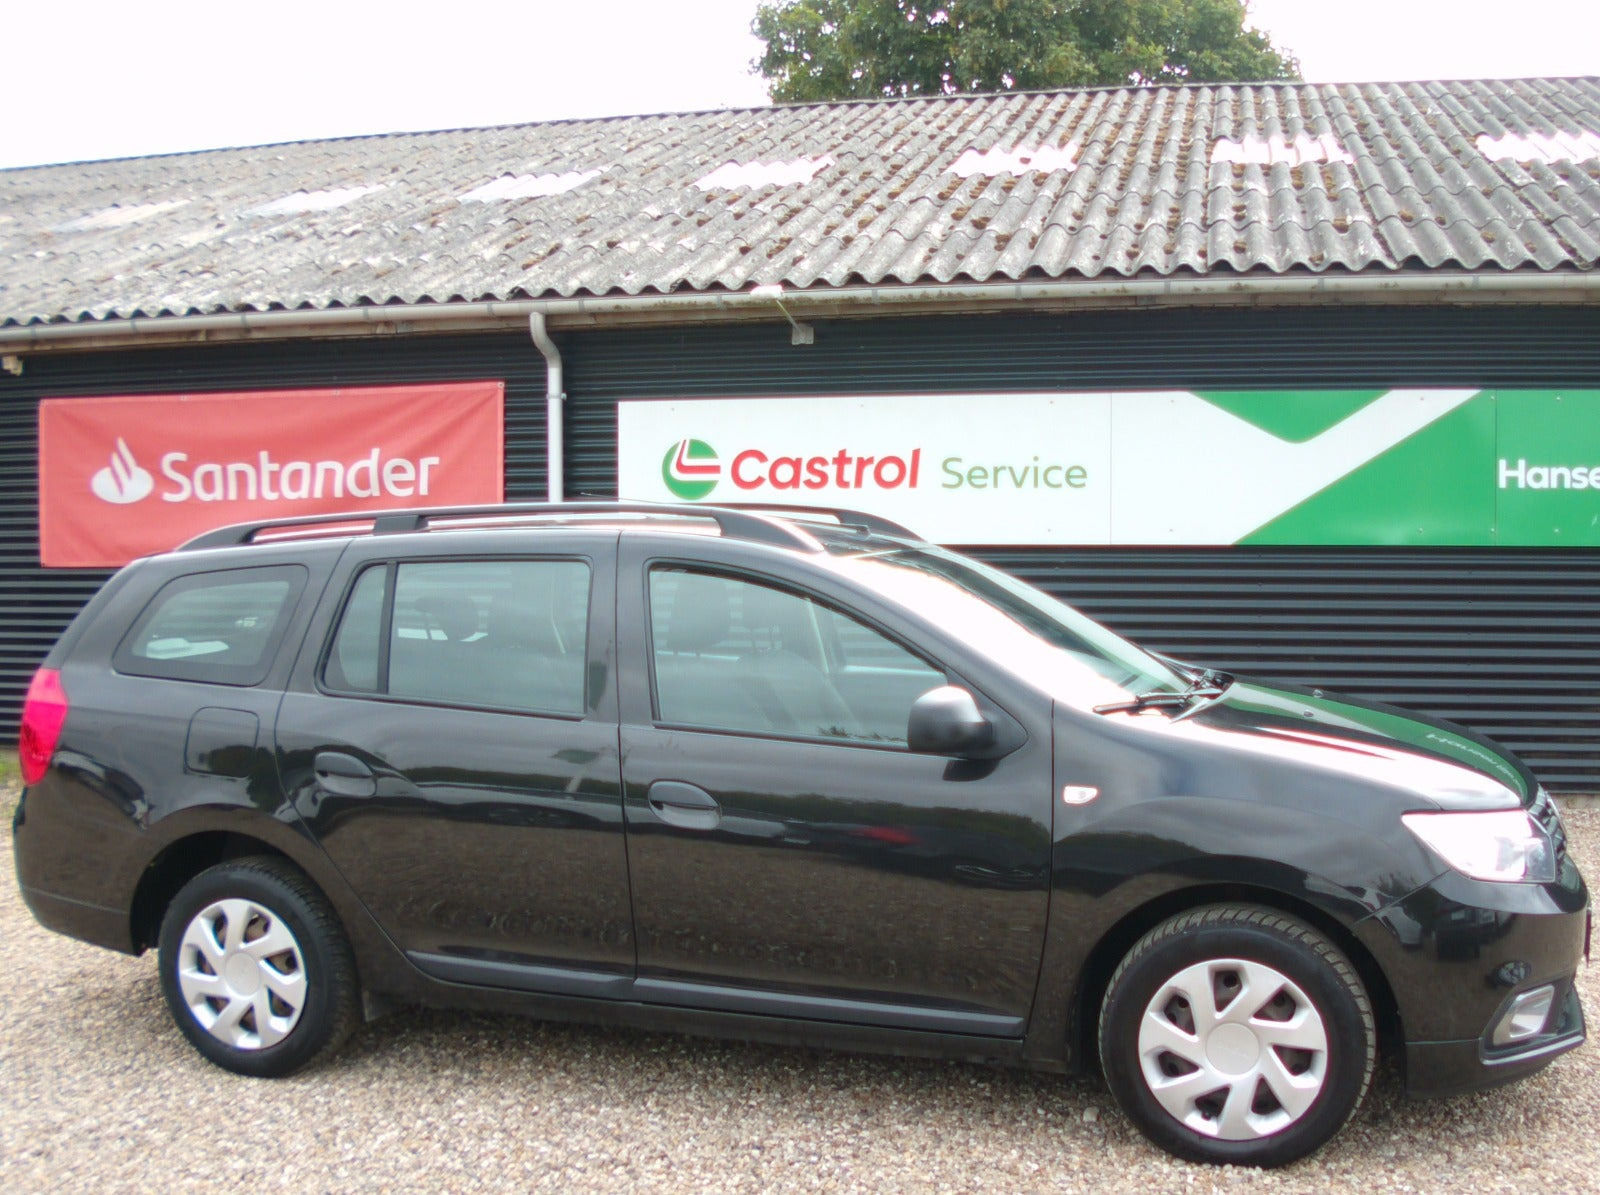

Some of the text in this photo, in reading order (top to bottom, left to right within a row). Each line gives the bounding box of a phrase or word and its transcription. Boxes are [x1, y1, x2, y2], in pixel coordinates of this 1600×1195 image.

[160, 447, 440, 503] Santander
[730, 447, 1087, 490] Castrol Service
